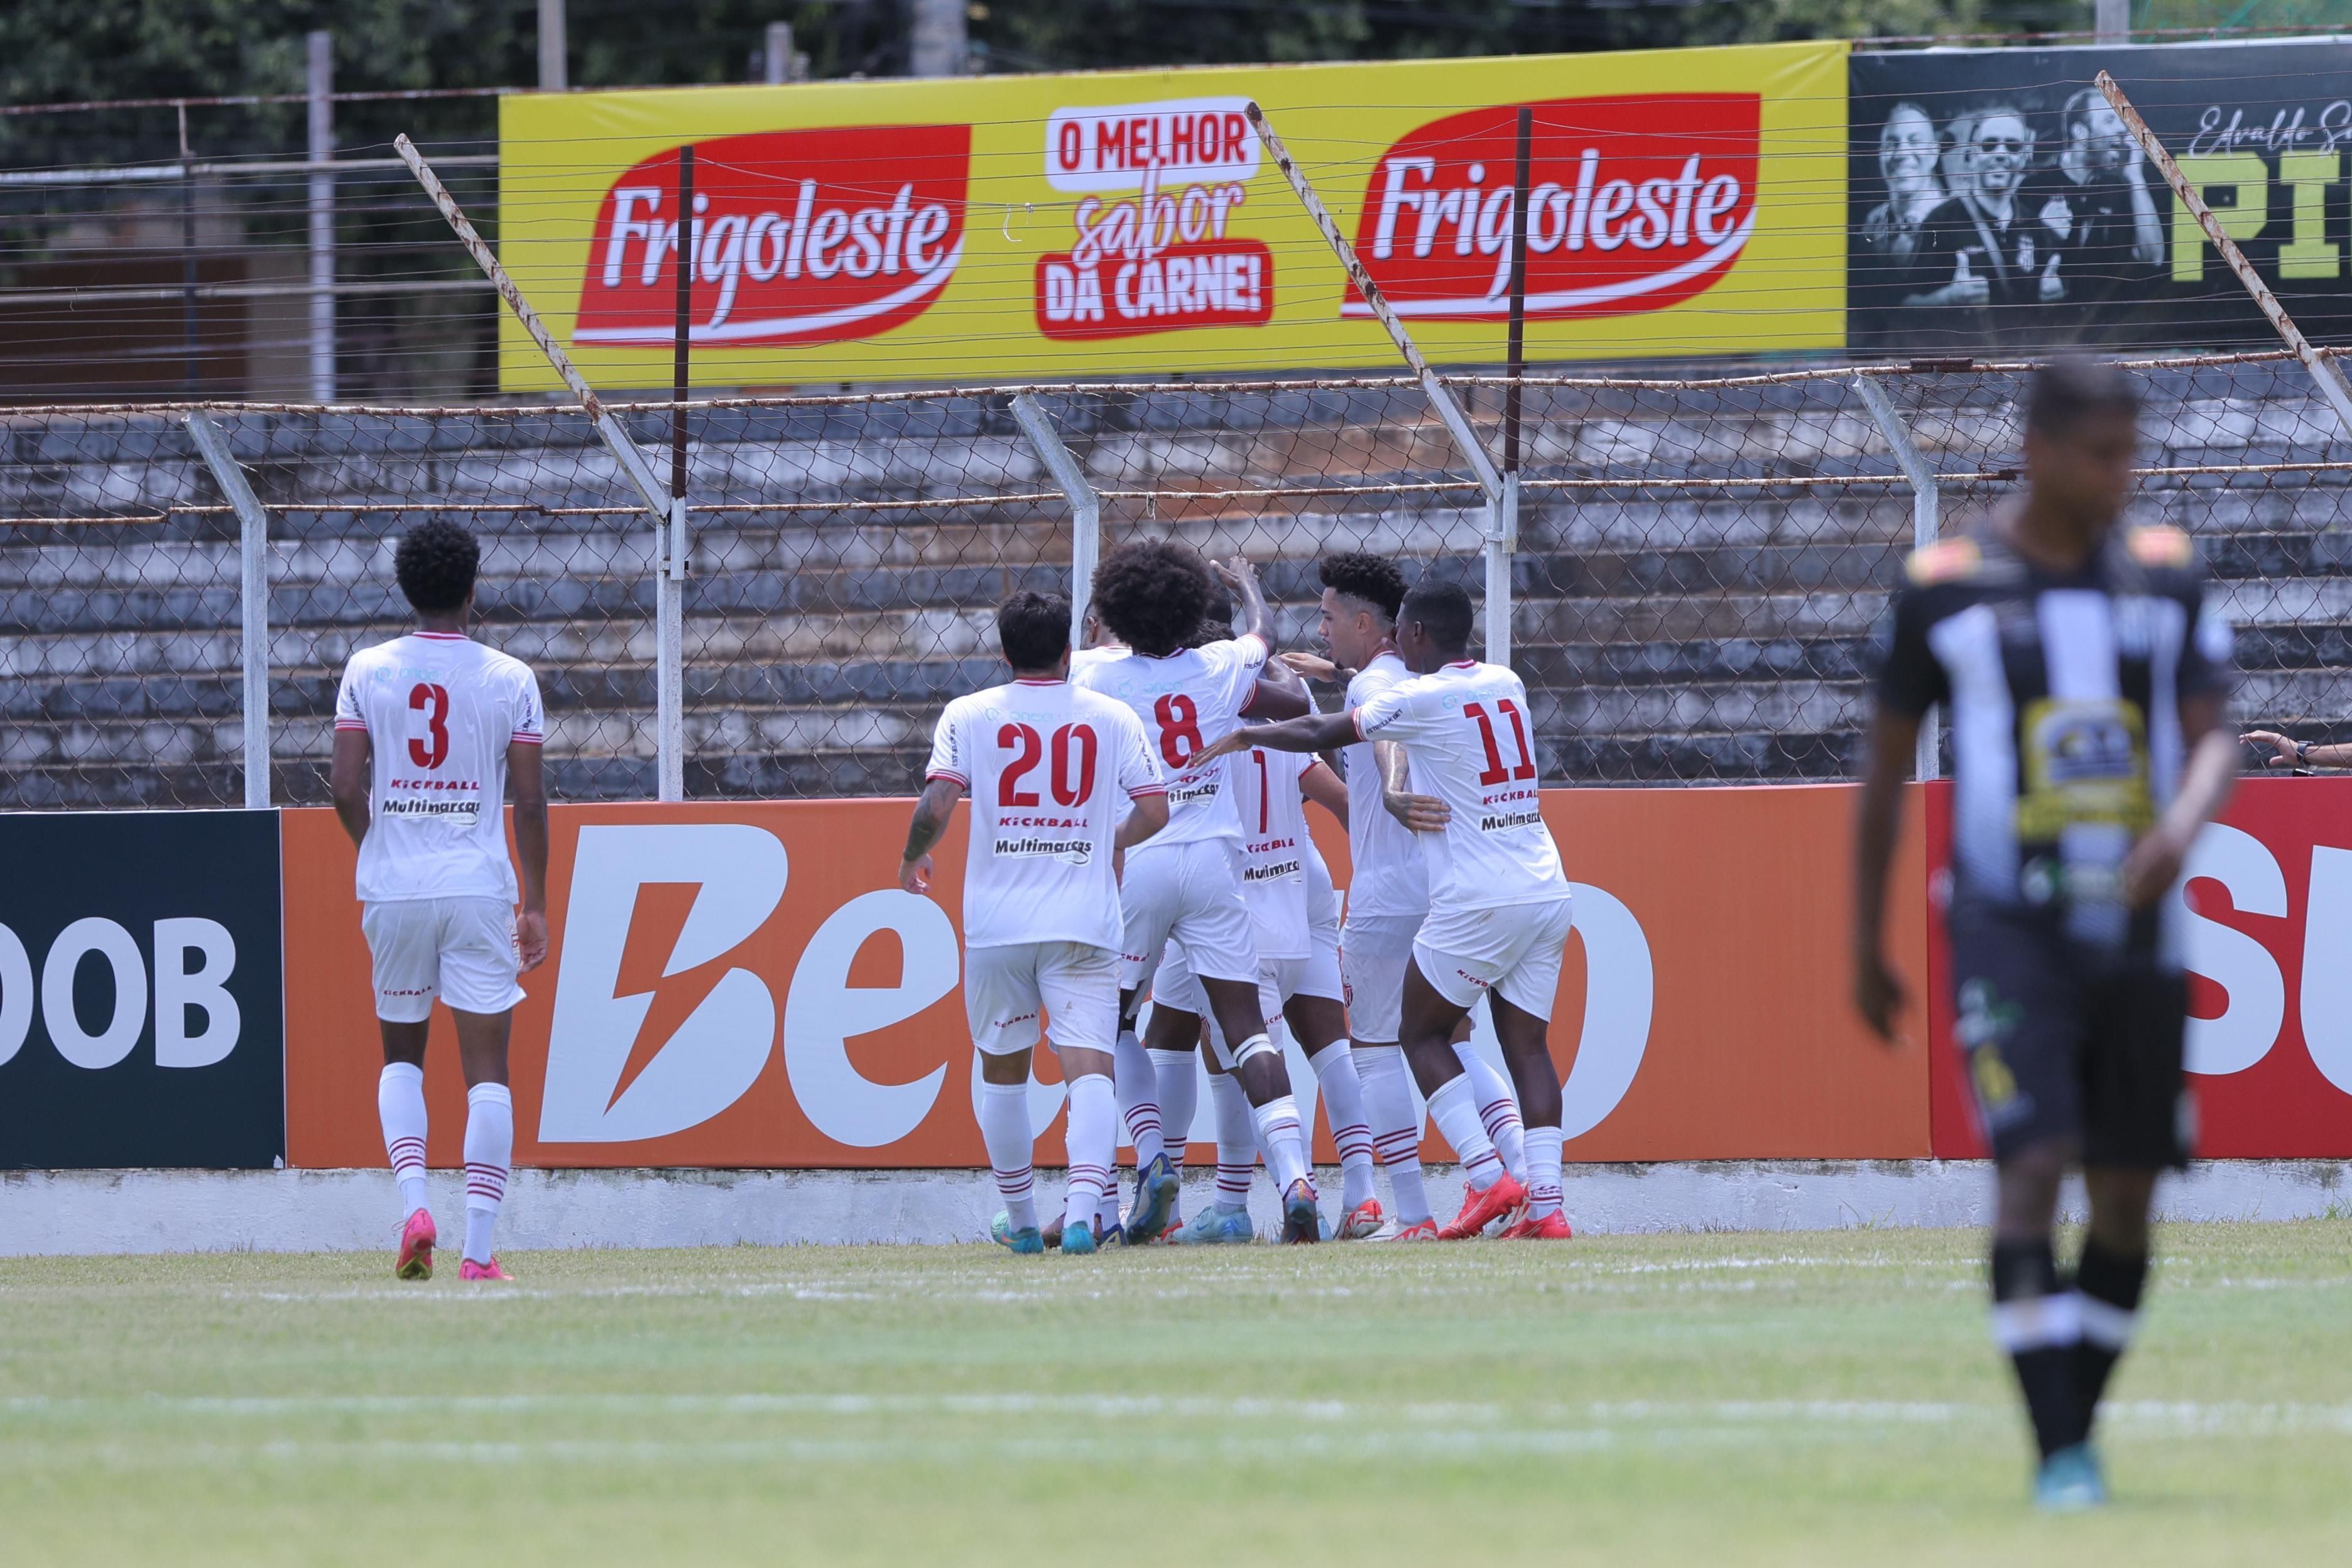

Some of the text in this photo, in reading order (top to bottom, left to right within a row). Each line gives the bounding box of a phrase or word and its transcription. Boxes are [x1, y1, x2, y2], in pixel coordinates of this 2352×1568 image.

[1060, 113, 1246, 171] O MELHOR
[602, 178, 951, 329] Frigoleste
[1072, 156, 1246, 270] sabor
[1373, 148, 1741, 302] Frigoleste
[2171, 149, 2352, 281] PI
[1046, 254, 1263, 322] DA CARNE!
[408, 682, 449, 770] 3
[997, 722, 1098, 808] 20
[1153, 692, 1204, 770] 8
[1462, 699, 1536, 787] 11
[383, 798, 481, 813] Multimarcas
[1483, 789, 1538, 805] KiCKBAL
[995, 838, 1092, 854] Multimarcas
[537, 824, 1653, 1147] Beo
